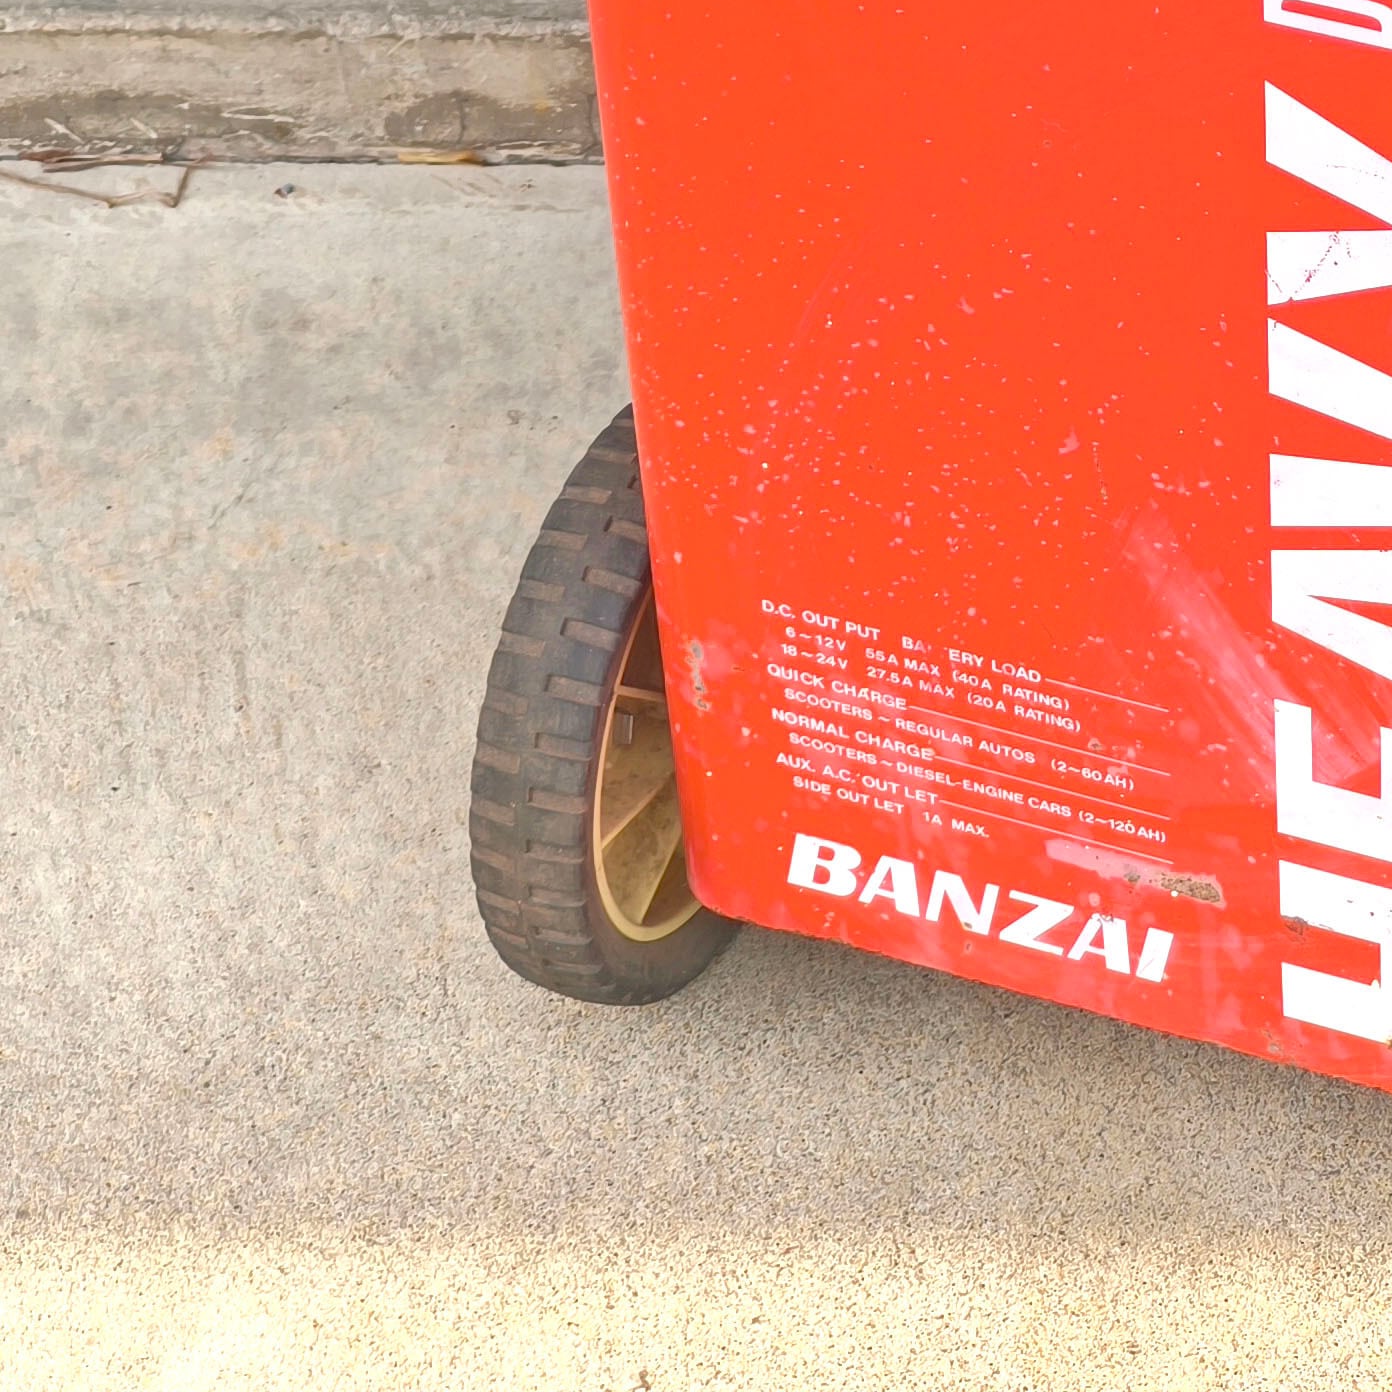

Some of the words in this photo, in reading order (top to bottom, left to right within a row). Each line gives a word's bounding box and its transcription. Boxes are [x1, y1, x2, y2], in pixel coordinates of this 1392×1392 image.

[761, 598, 795, 620] D.C.
[802, 609, 840, 632] OUT
[845, 620, 880, 643] PUT
[901, 635, 984, 670] BAERY
[991, 658, 1041, 685] LOAD
[766, 661, 825, 691] QUICK
[831, 678, 907, 712] CHARGE
[903, 656, 940, 678] MAX
[1002, 682, 1070, 712] RATING)
[918, 678, 955, 700] MAX
[1014, 703, 1081, 733] RATING)
[771, 707, 849, 740] NORMAL
[854, 729, 935, 763] CHARGE
[784, 687, 873, 723] SCOOTERS
[894, 716, 973, 749] REGULAR
[978, 738, 1035, 766] AUTOS
[775, 751, 816, 774] AUX.
[821, 763, 855, 784] A.C.
[861, 773, 899, 796] OUT
[904, 784, 938, 806] LET
[789, 732, 877, 768] SCOOTERS
[896, 760, 1024, 806] DIESEL-ENGINE
[1027, 794, 1071, 819] CARS
[792, 774, 831, 797] SIDE
[836, 786, 869, 807] OUT
[873, 796, 904, 816] LET
[922, 808, 942, 826] 1A
[951, 816, 990, 838] MAX.
[786, 833, 1174, 983] BANZAI
